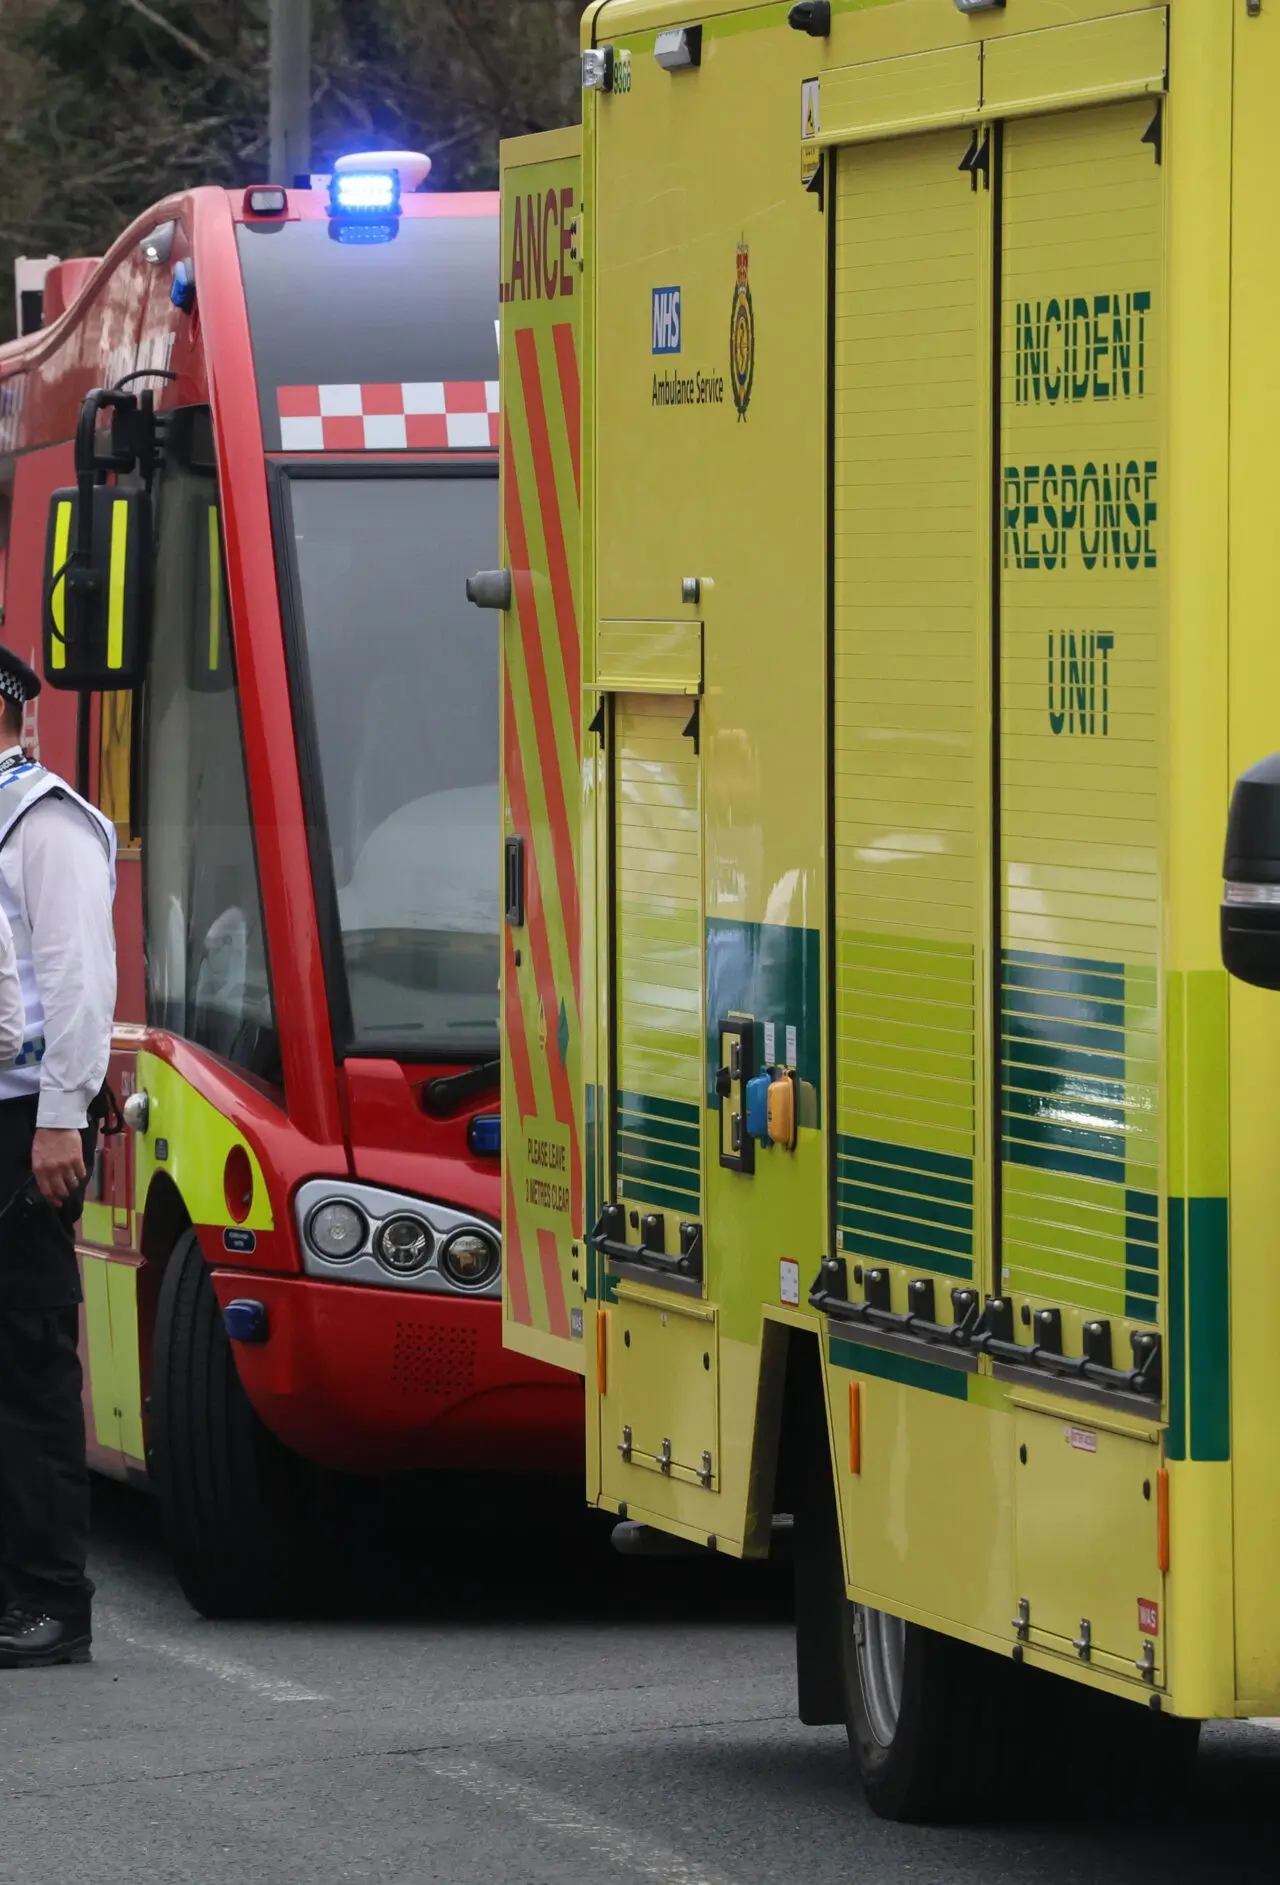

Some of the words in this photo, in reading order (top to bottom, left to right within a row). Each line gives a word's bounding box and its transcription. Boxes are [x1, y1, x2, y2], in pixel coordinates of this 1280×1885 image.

[653, 291, 680, 349] NHS
[1015, 291, 1151, 407] INCIDENT
[652, 369, 694, 406] Ambulance
[696, 368, 724, 405] Service
[1003, 460, 1158, 570] RESPONSE
[1048, 629, 1114, 737] UNIT
[527, 1137, 548, 1167] PLEASE
[549, 1143, 566, 1172] LEAVE
[530, 1178, 551, 1208] METRES
[552, 1184, 570, 1213] CLEAR
[1139, 1605, 1156, 1629] WAS
